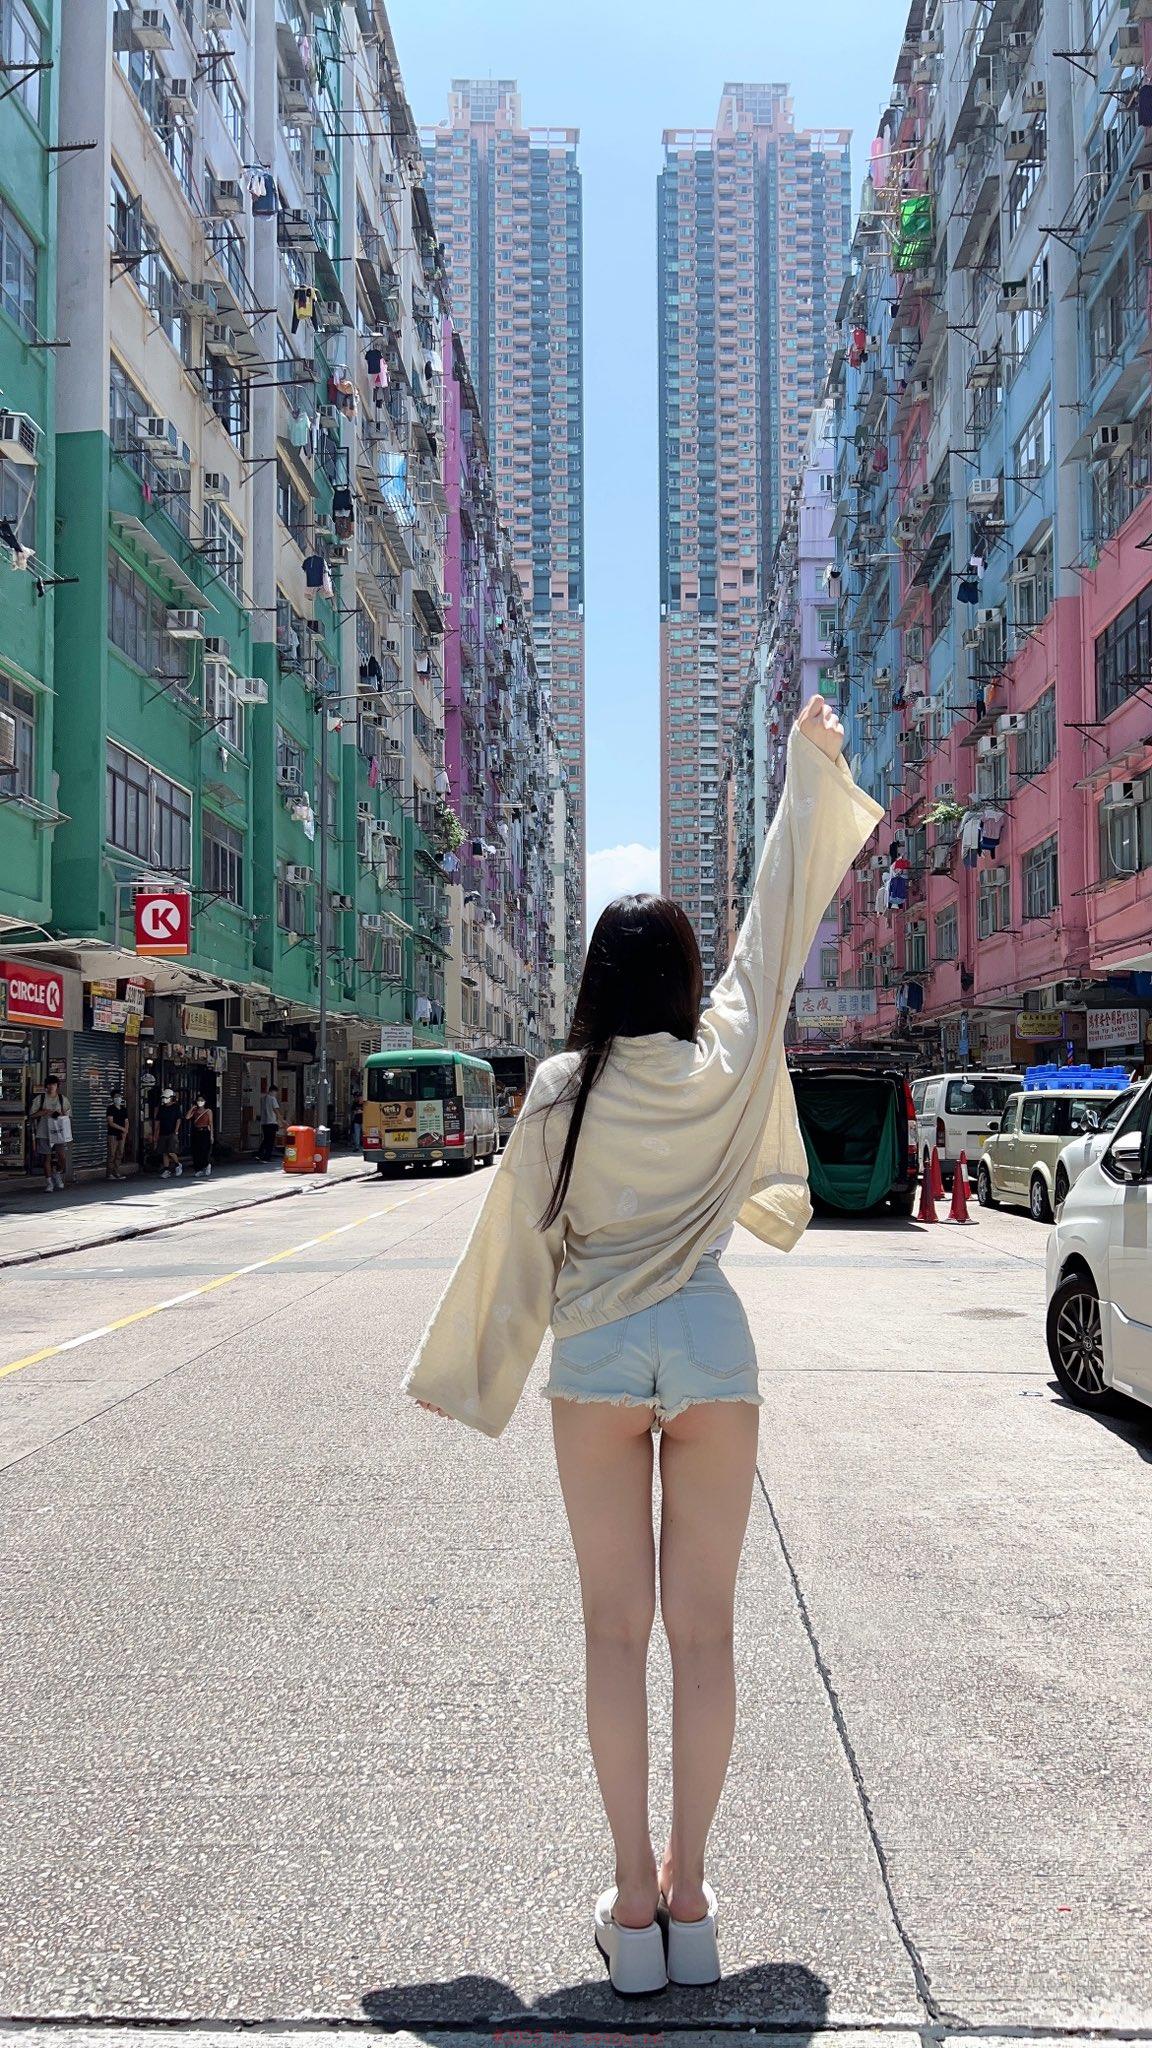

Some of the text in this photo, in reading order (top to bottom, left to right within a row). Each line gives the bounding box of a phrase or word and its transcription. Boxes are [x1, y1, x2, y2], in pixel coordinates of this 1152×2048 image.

[150, 906, 179, 935] K
[10, 979, 46, 1004] CIRCLE
[47, 984, 61, 1011] K
